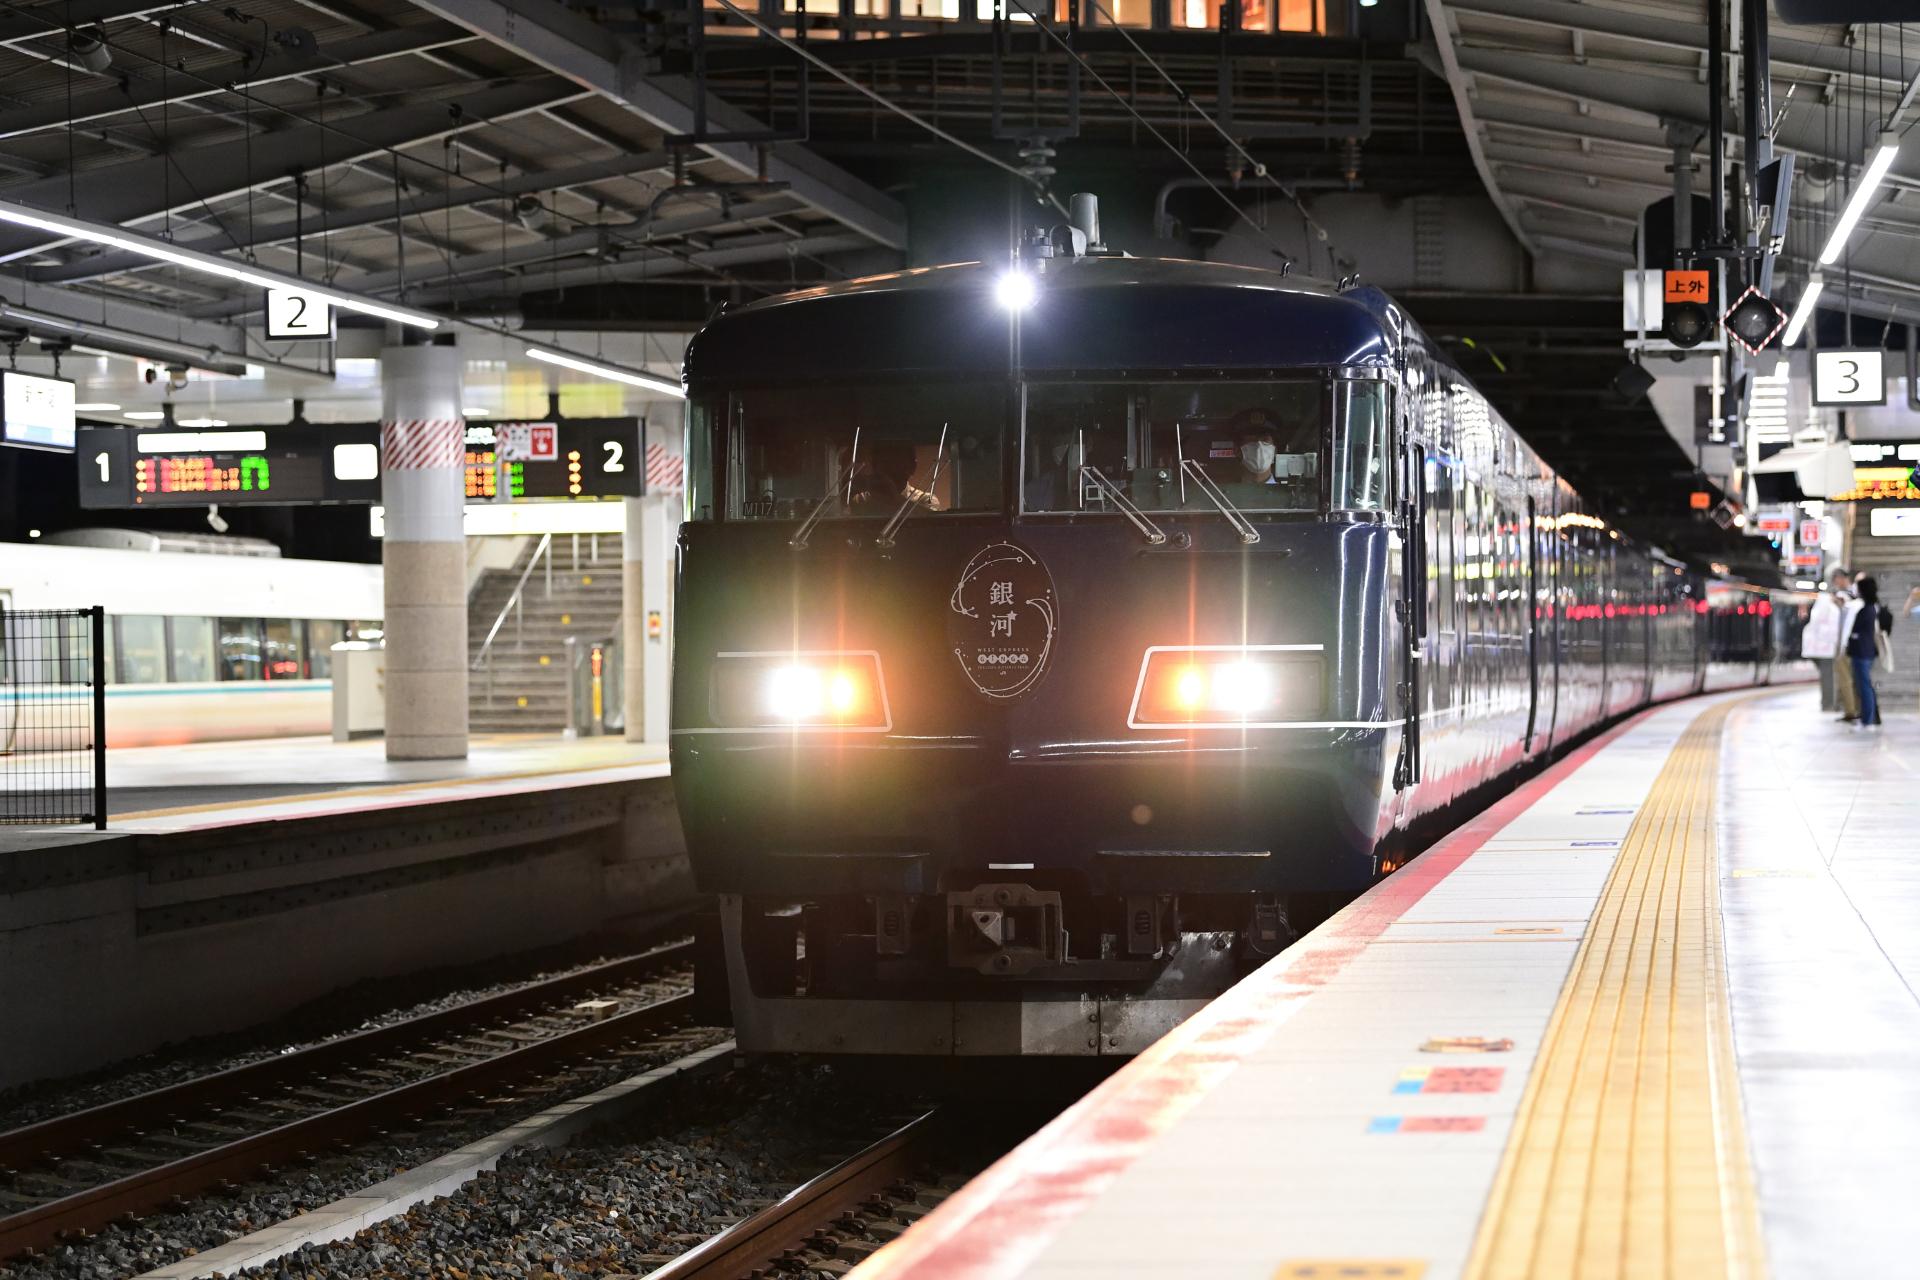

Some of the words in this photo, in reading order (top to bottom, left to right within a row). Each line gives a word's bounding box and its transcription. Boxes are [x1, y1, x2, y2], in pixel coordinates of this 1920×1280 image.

[1668, 279, 1705, 294] 上外
[287, 296, 308, 328] 2
[1837, 360, 1861, 394] 3
[95, 452, 110, 482] 1
[602, 440, 625, 473] 2
[744, 502, 773, 516] M117
[989, 581, 1018, 638] 銀河
